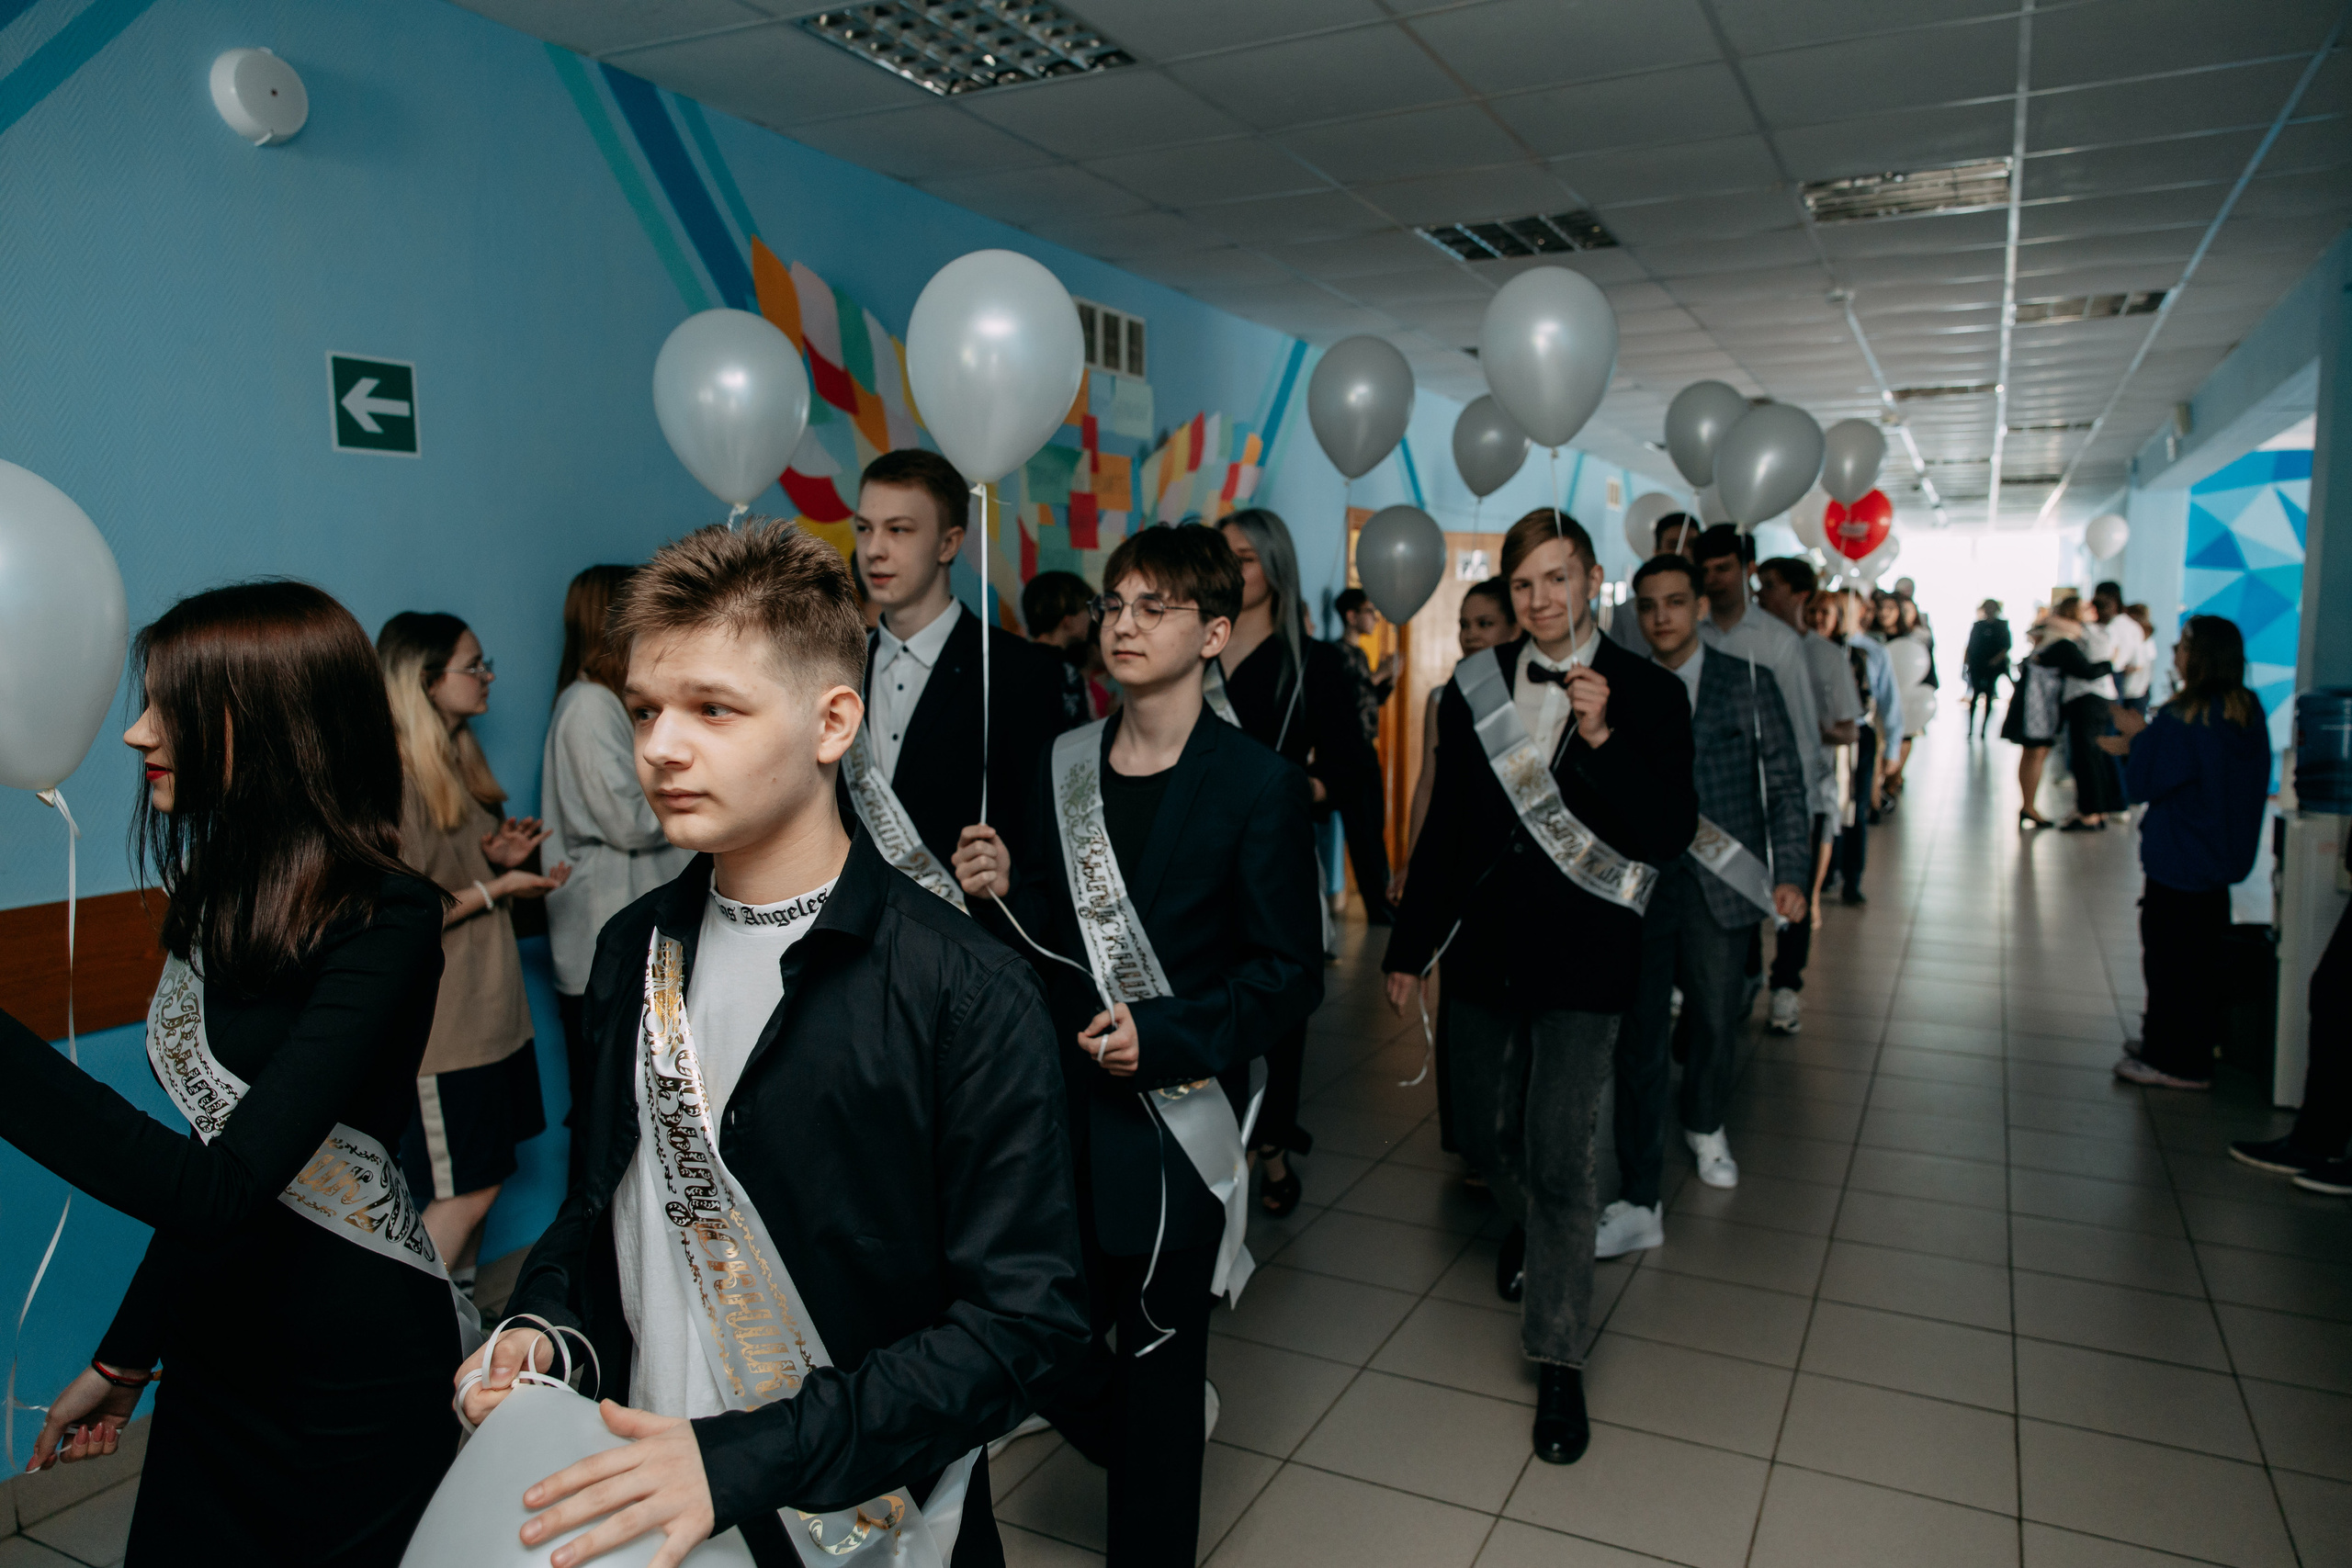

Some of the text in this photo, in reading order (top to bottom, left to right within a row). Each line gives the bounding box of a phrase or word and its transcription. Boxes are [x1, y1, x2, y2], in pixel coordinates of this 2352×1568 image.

[849, 742, 907, 860] ыпускник
[711, 887, 829, 928] os Angeles
[654, 1049, 803, 1402] Выпускник
